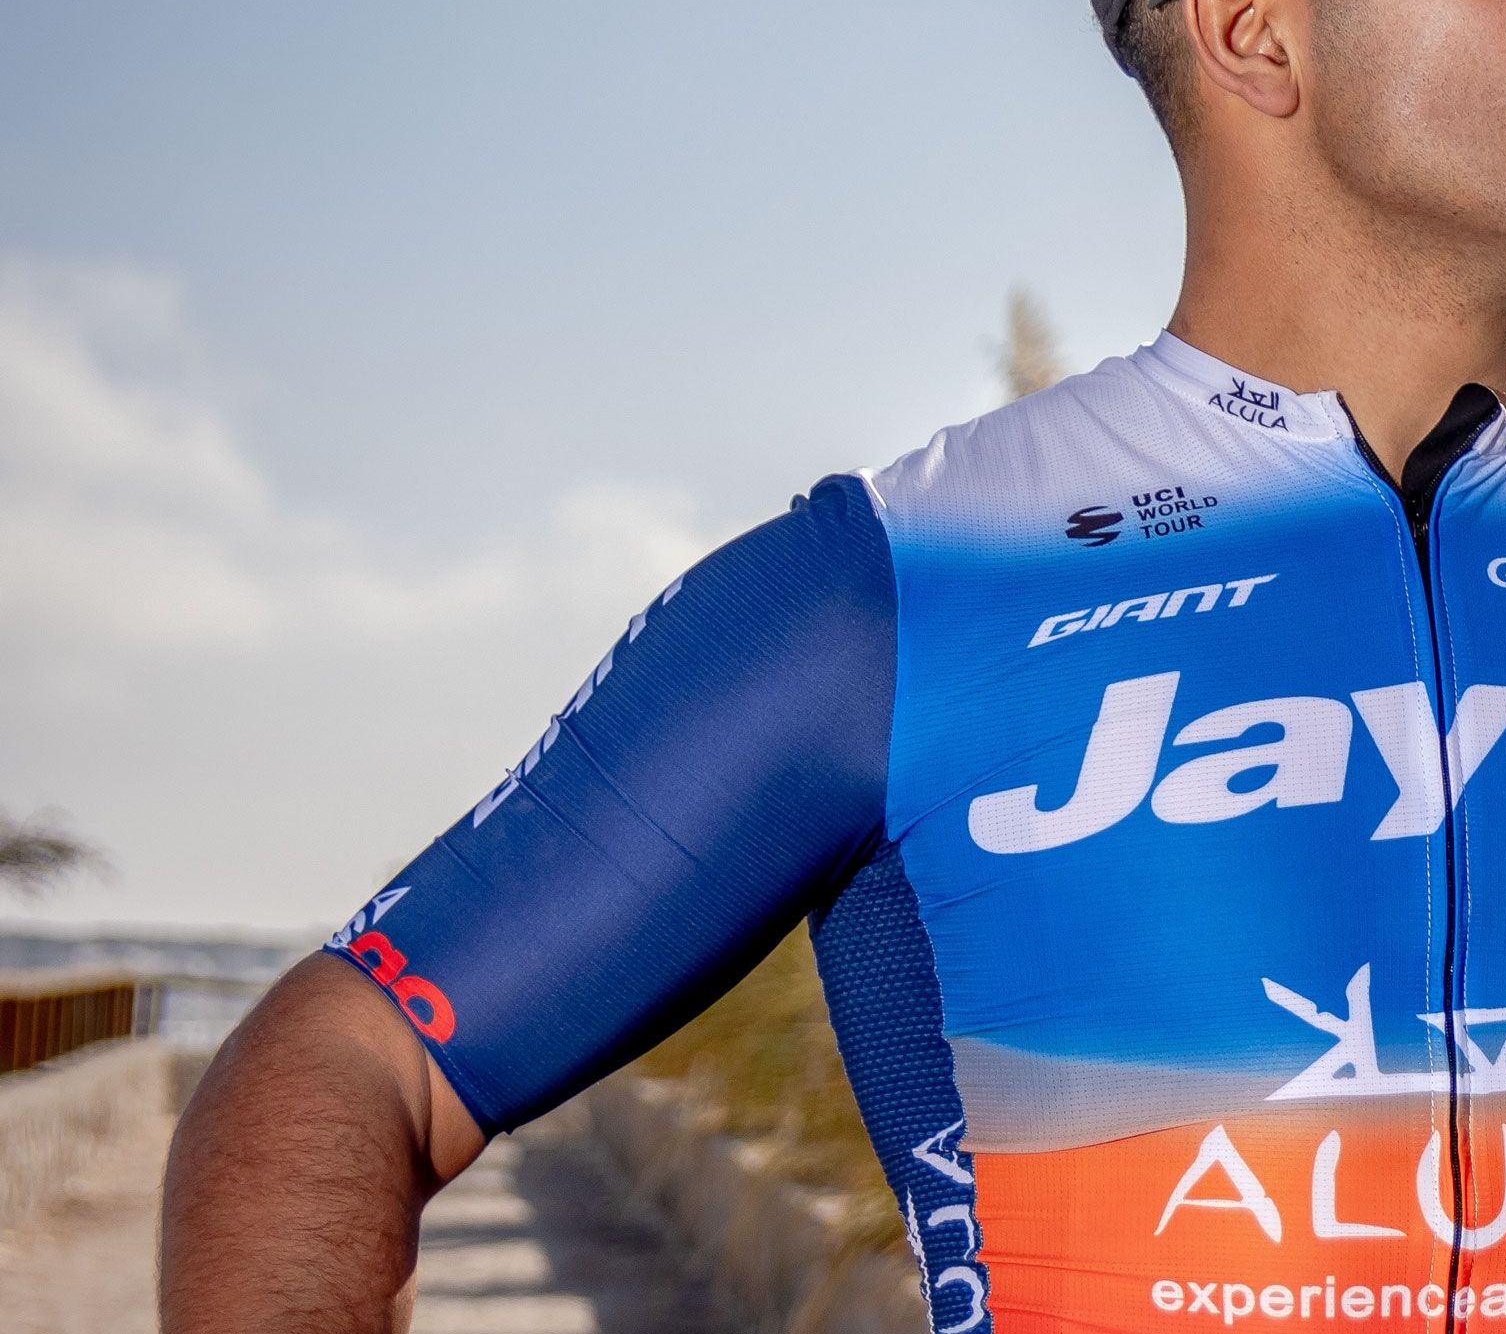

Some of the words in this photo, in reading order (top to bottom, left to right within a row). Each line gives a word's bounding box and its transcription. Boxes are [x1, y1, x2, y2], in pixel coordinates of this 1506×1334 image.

[1208, 393, 1289, 432] ALULA
[1132, 486, 1185, 508] UCI
[1136, 494, 1219, 523] WORLD
[1139, 514, 1205, 540] TOUR
[1026, 573, 1280, 649] GIANT
